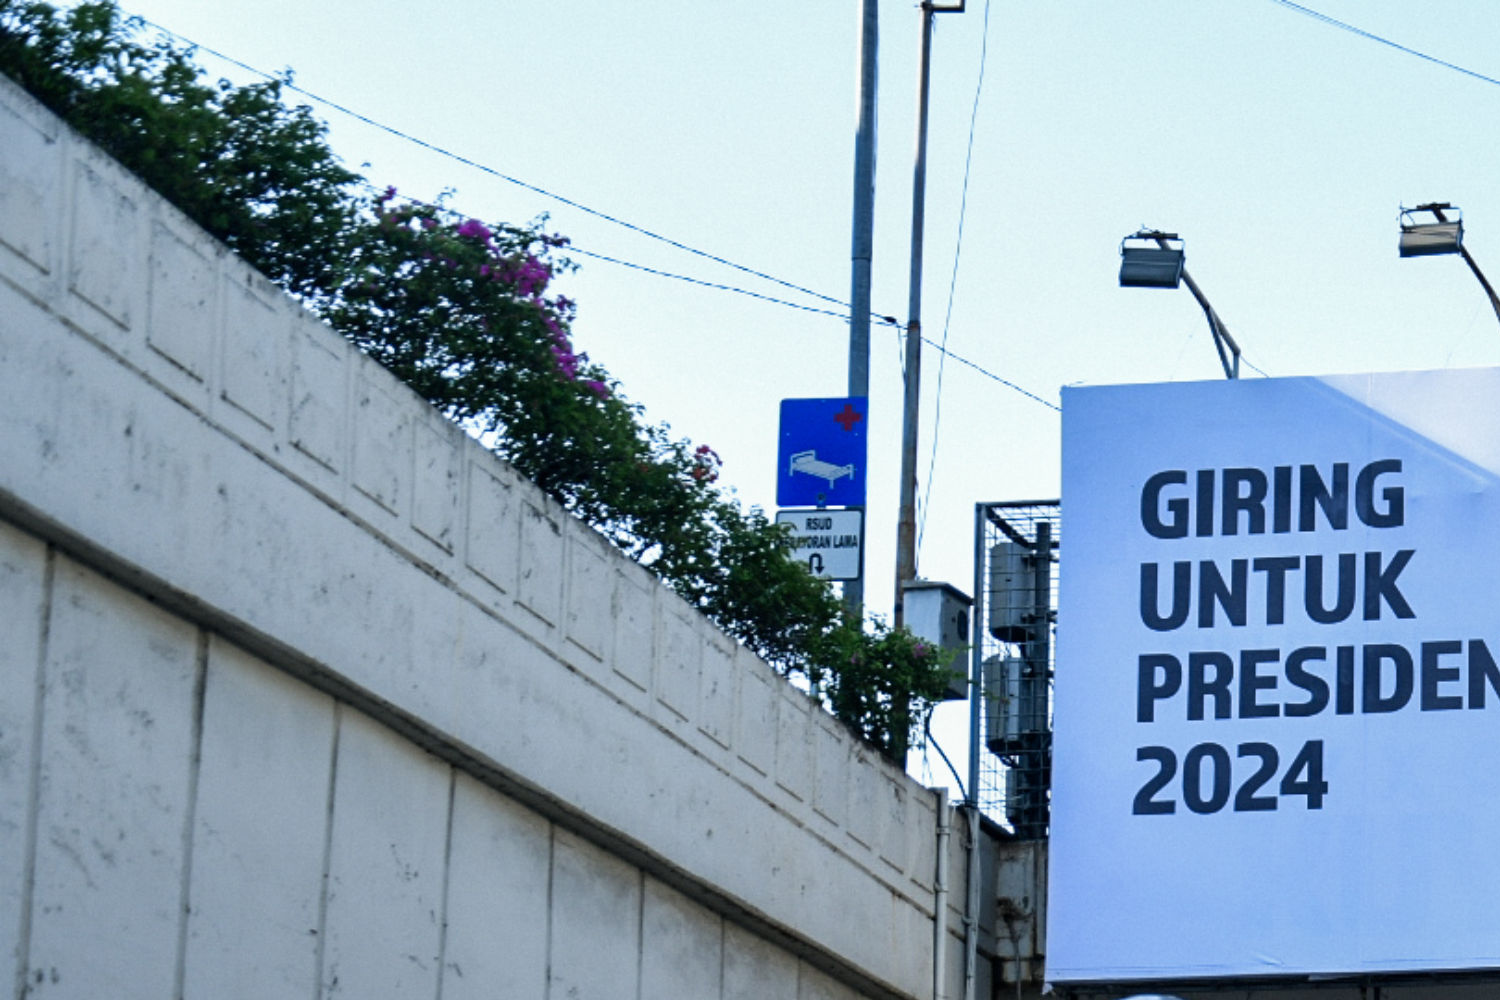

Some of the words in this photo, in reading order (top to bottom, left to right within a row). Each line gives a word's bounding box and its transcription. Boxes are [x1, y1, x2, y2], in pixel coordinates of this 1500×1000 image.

[806, 517, 832, 531] RSUD
[1140, 459, 1404, 539] GIRING
[833, 534, 858, 549] LAMA
[1140, 549, 1417, 632] UNTUK
[1132, 739, 1329, 816] 2024
